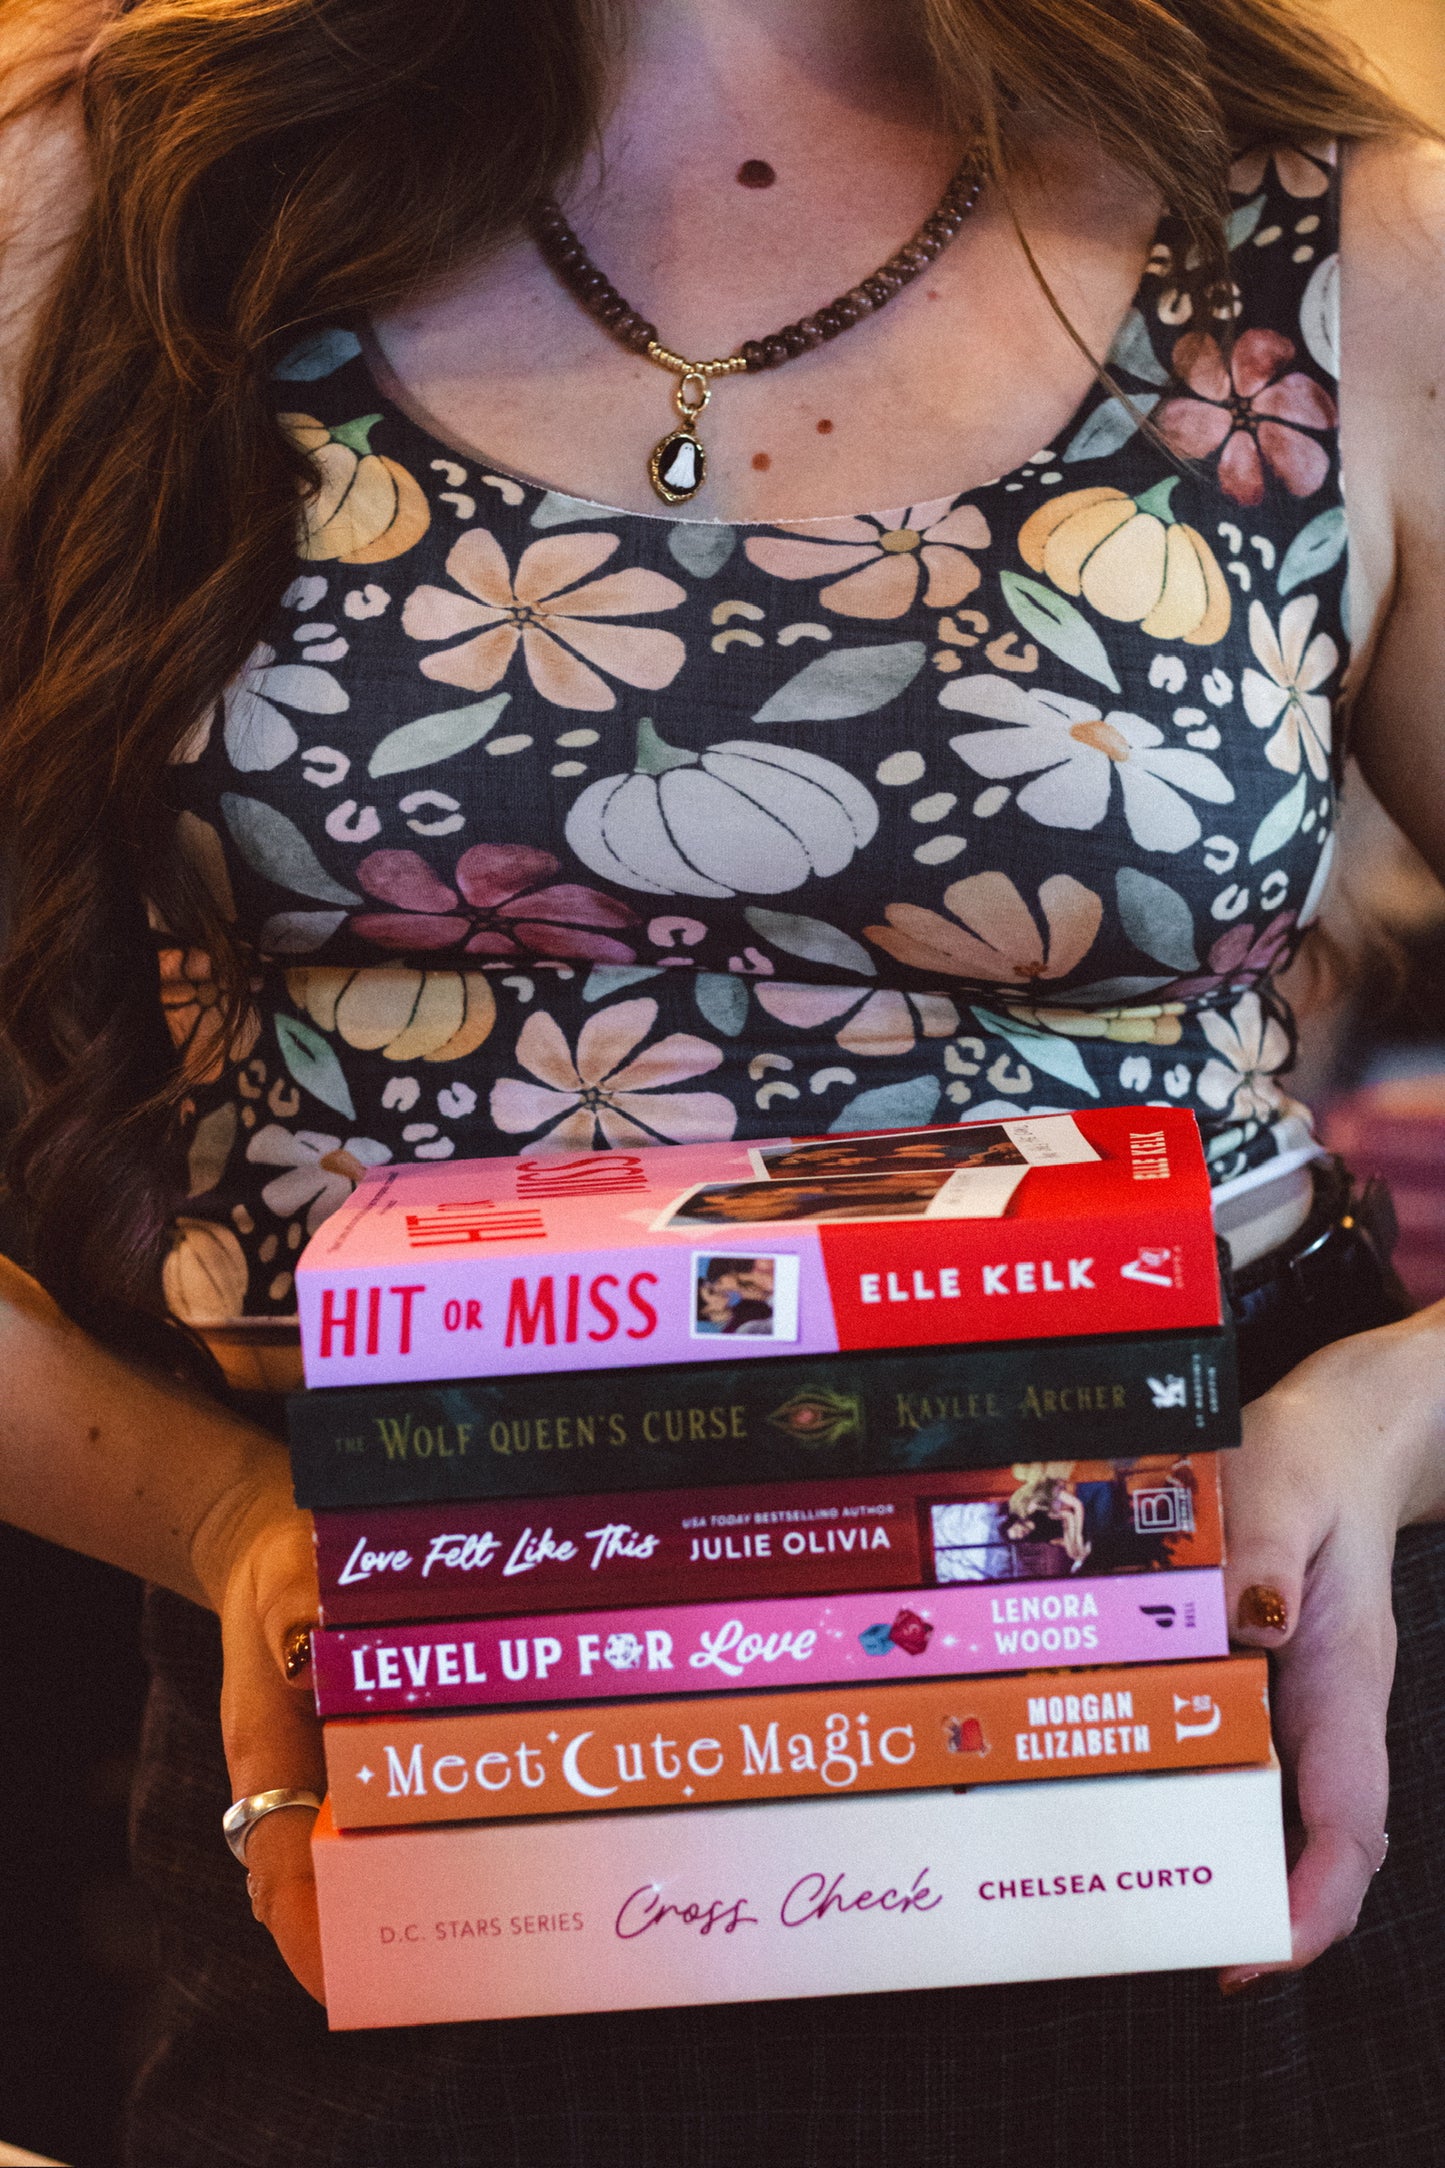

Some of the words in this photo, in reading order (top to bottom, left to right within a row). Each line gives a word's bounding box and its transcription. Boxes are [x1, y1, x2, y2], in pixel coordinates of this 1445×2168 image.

[1129, 1130, 1167, 1156] KELK
[1131, 1157, 1171, 1181] ELLE
[859, 1268, 961, 1303] ELLE
[982, 1258, 1096, 1295] KELK
[320, 1284, 426, 1358] HIT
[443, 1299, 483, 1331] OR
[505, 1271, 659, 1348] MISS
[642, 1404, 748, 1444] CURSE
[681, 1516, 706, 1529] USA
[711, 1513, 751, 1527] TODAY
[754, 1507, 839, 1524] BESTSELLING
[842, 1503, 895, 1518] AUTHOR
[338, 1536, 413, 1586] Love
[421, 1531, 503, 1577] Felt
[502, 1527, 579, 1577] Like
[585, 1523, 660, 1570] This
[690, 1533, 772, 1562] JULIE
[783, 1526, 891, 1555] OLIVIA
[991, 1593, 1099, 1624] LENORA
[351, 1640, 486, 1691] LEVEL
[499, 1637, 562, 1681] UP
[689, 1619, 818, 1677] Love
[995, 1625, 1099, 1656] WOODS
[1027, 1691, 1134, 1726] MORGAN
[383, 1740, 547, 1798] Meet
[562, 1731, 724, 1797] Cute
[739, 1712, 917, 1787] Magic
[1015, 1725, 1150, 1762] ELIZABETH
[978, 1874, 1106, 1901] CHELSEA
[1117, 1866, 1213, 1891] CURTO
[615, 1884, 757, 1939] Cross
[780, 1867, 943, 1928] Check
[379, 1924, 425, 1945] D.C.
[436, 1915, 502, 1939] STARS
[510, 1912, 584, 1936] SERIES
